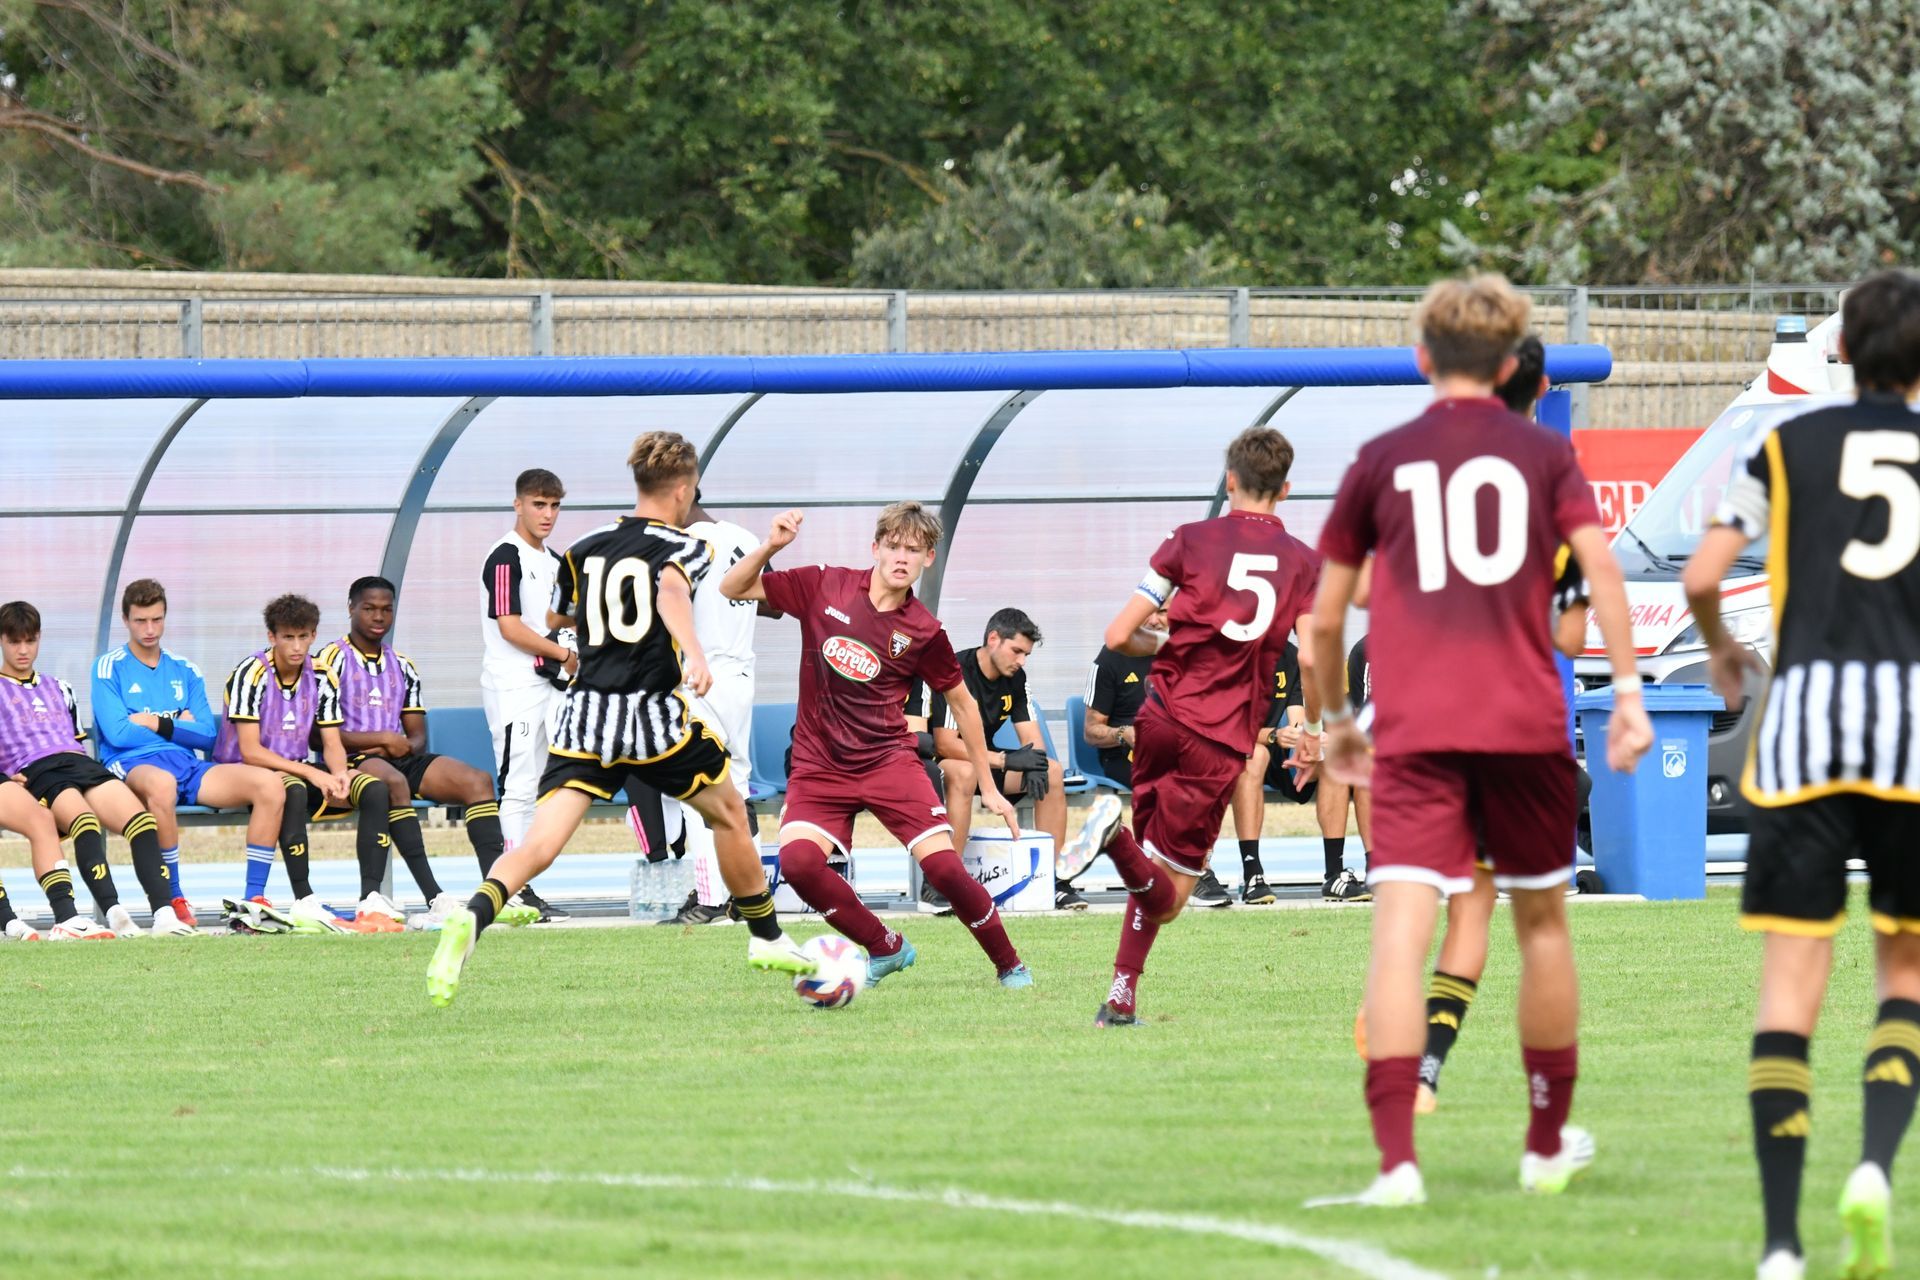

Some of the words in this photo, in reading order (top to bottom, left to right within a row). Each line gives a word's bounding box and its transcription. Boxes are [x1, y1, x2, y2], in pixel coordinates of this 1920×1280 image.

[1393, 455, 1530, 593] 10
[1839, 429, 1920, 580] 5
[583, 556, 652, 646] 10
[1220, 552, 1278, 642] 5
[824, 639, 878, 678] Beretta
